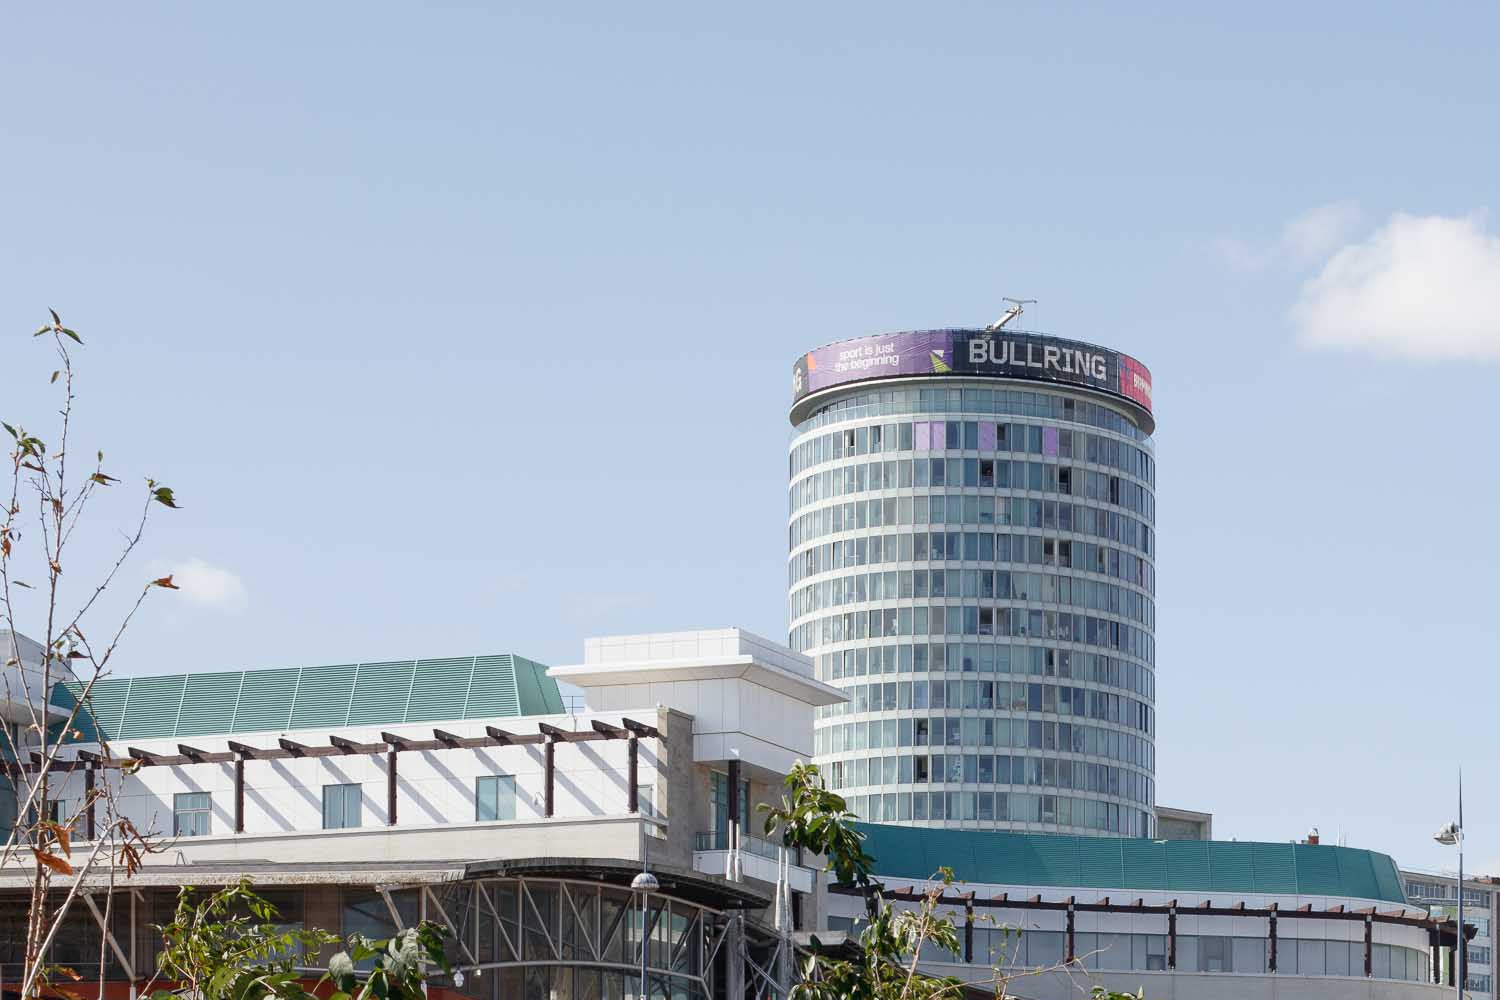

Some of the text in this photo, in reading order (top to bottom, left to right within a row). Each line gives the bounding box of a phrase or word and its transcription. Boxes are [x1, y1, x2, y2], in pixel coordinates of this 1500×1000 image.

[840, 342, 895, 361] sport is just
[969, 339, 1106, 382] BULLRING
[850, 354, 899, 370] beginning
